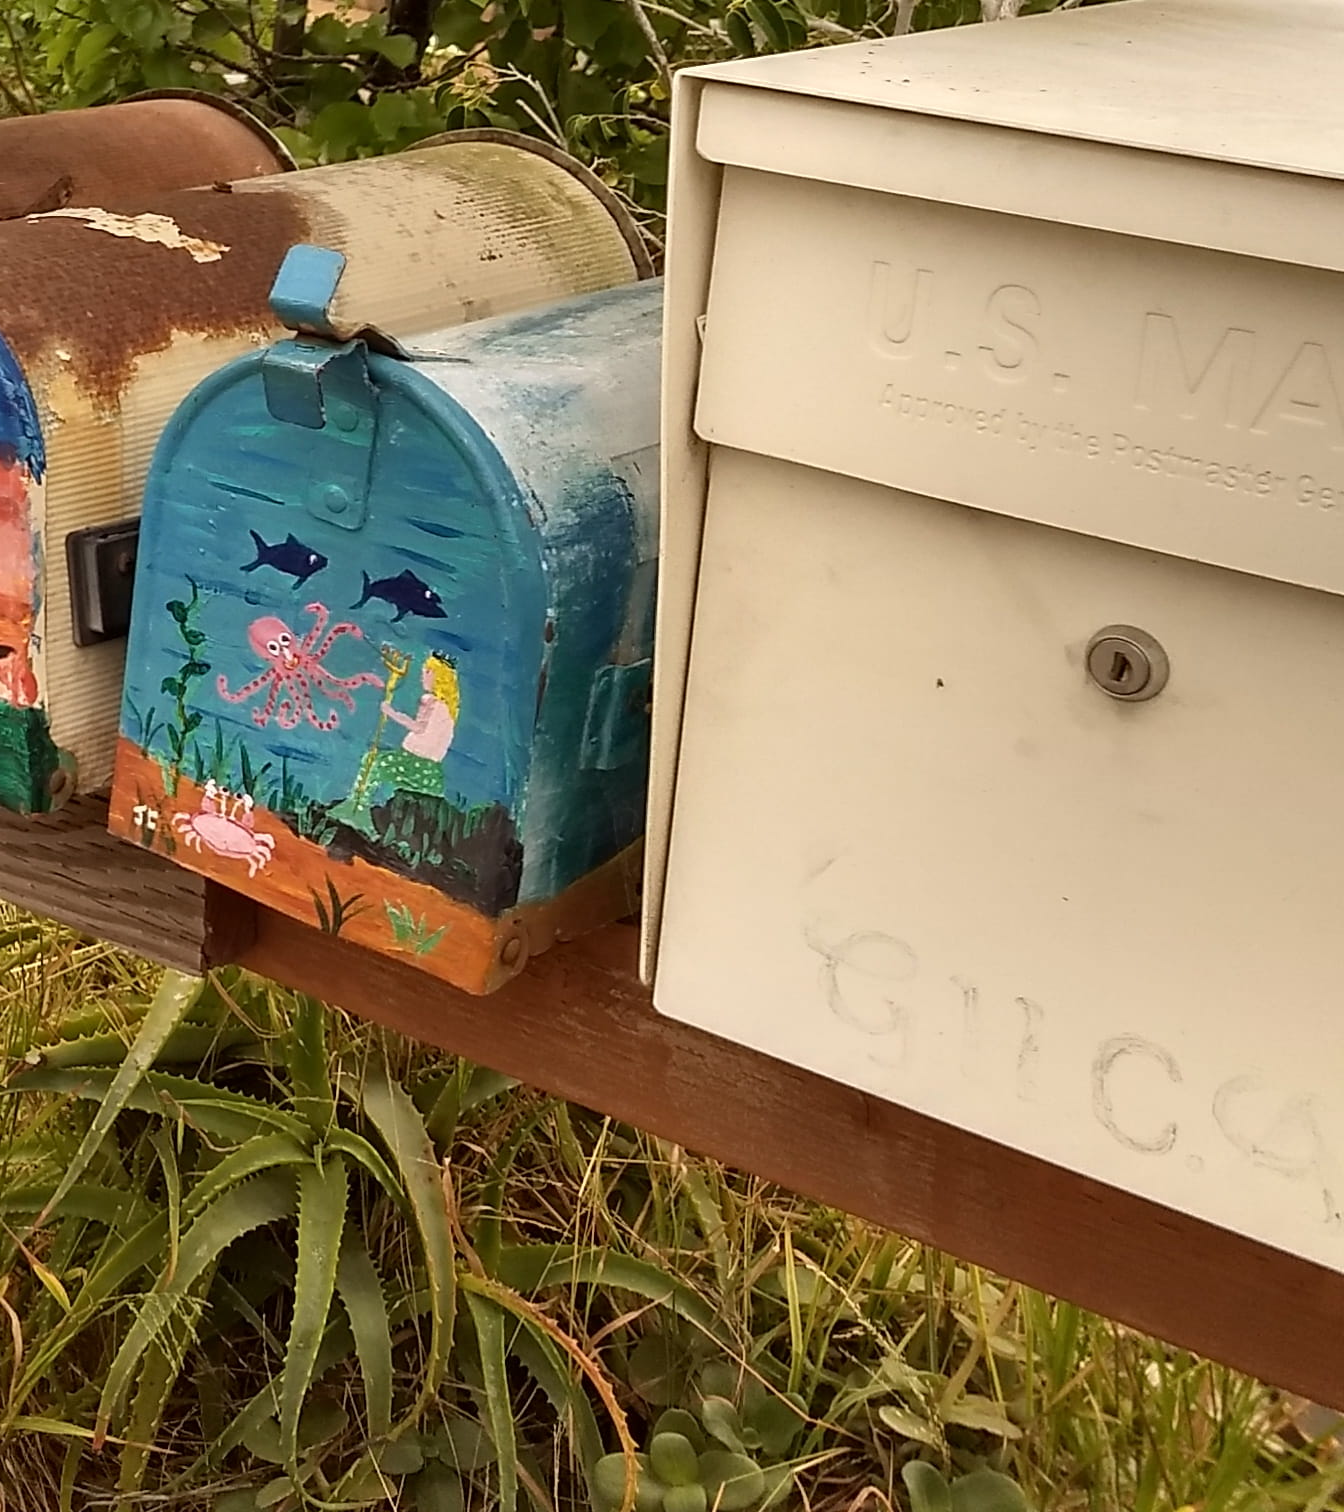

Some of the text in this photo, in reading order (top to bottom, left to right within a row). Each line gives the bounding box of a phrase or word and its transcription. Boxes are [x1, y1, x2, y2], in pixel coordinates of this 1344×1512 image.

[867, 259, 1071, 393] U.S.
[879, 382, 1344, 511] Approved by the Postmaster Ge
